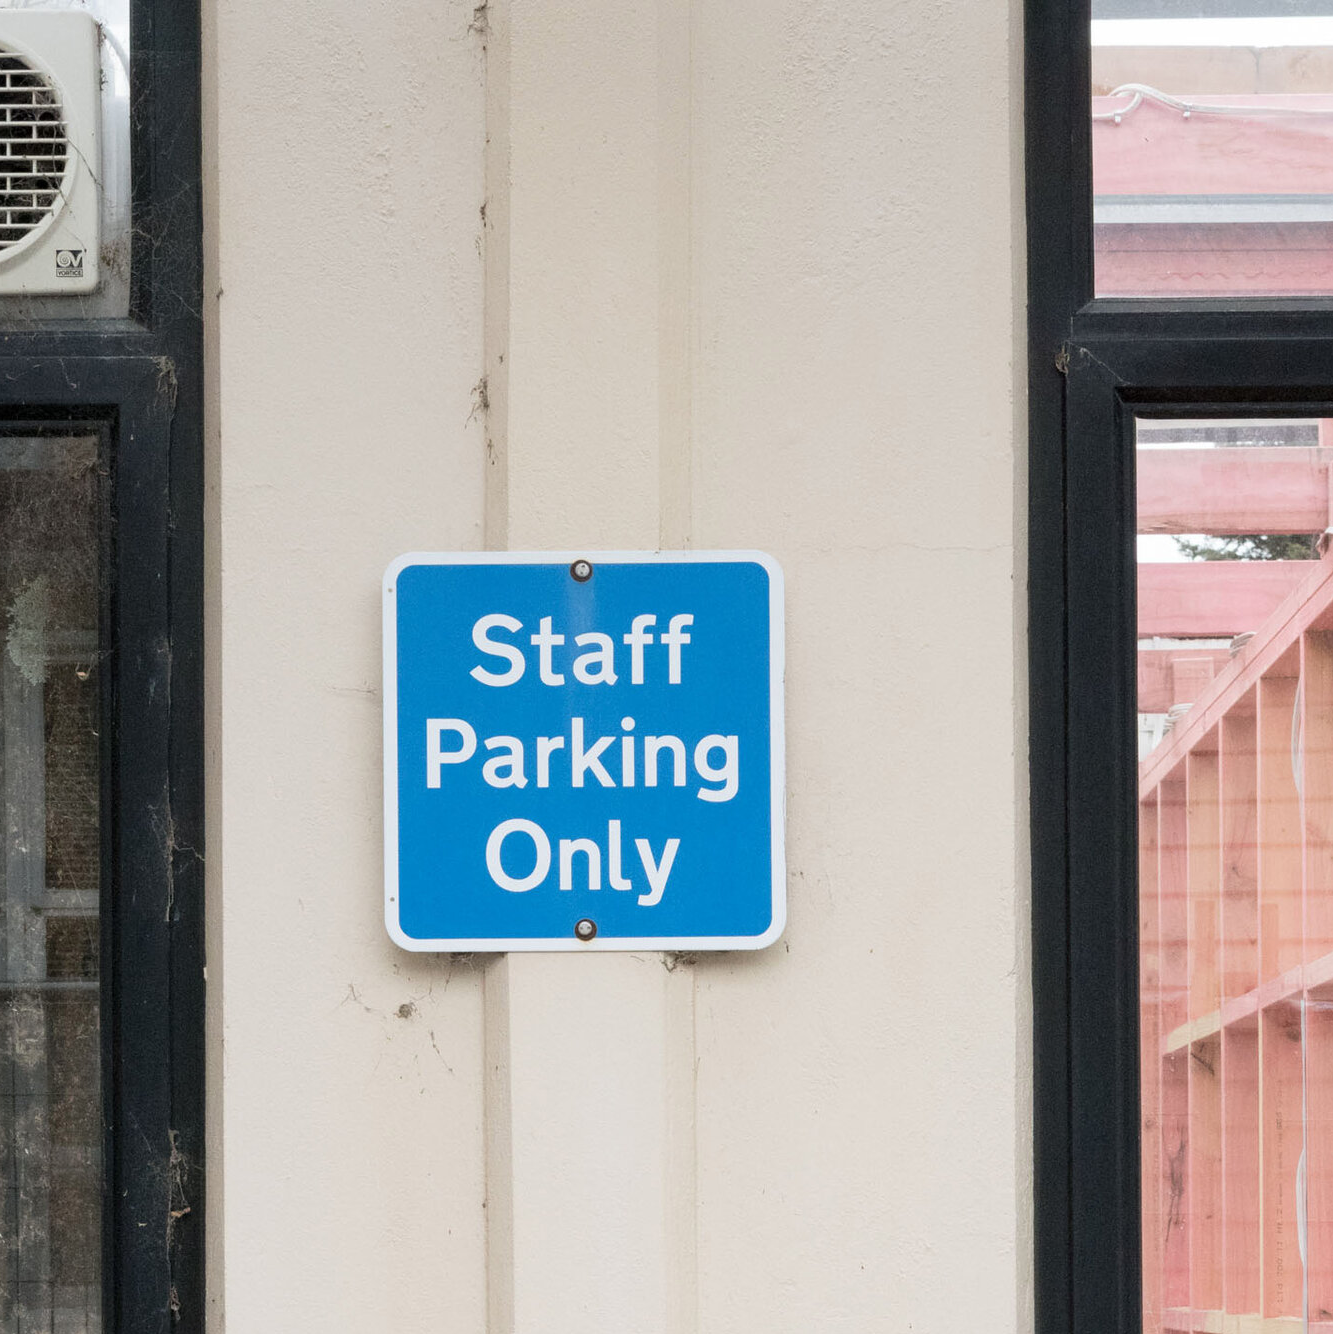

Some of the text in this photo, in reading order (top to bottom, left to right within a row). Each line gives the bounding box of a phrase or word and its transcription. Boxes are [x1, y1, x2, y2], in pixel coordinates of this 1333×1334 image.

[469, 612, 694, 688] Staff
[426, 715, 740, 802] Parking
[485, 818, 680, 906] Only
